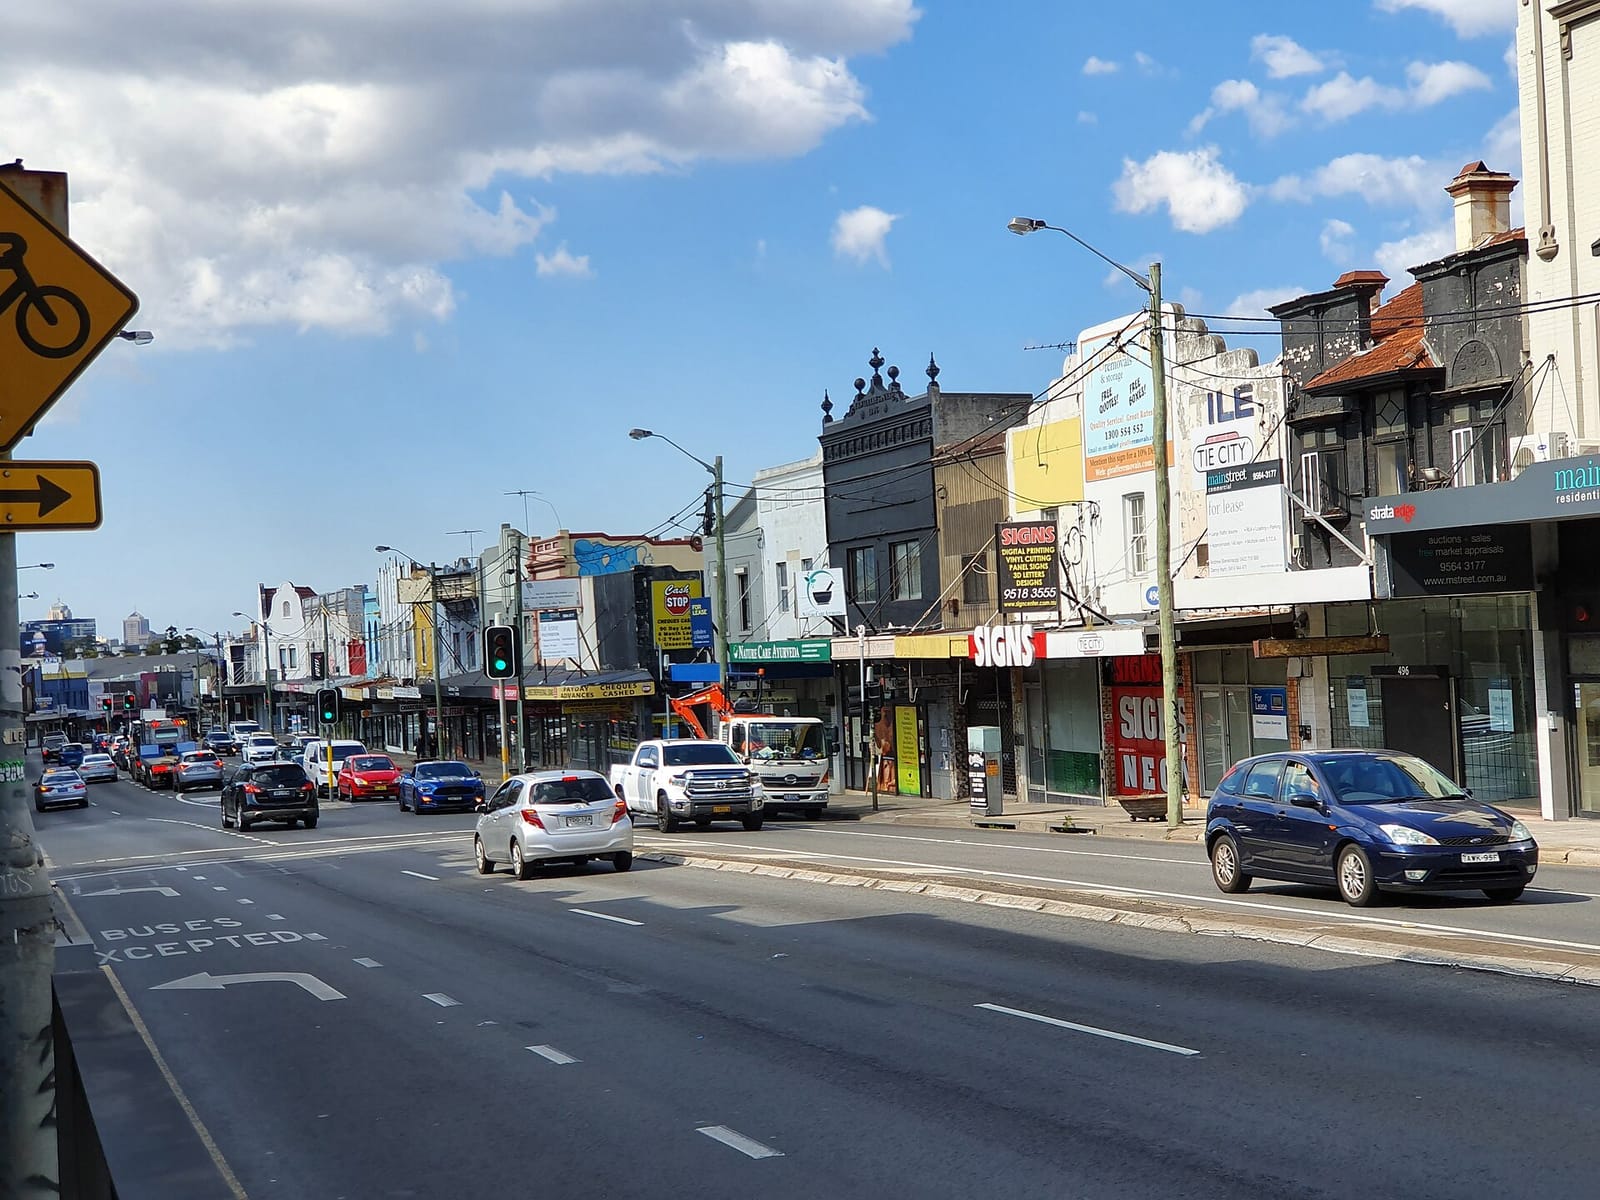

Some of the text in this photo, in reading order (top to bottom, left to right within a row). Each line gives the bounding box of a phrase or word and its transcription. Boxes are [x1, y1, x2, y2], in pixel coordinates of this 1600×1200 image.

[1130, 377, 1141, 394] FREE
[1101, 387, 1112, 402] FREE
[1129, 384, 1146, 406] BOXES!
[1099, 394, 1119, 414] QUOTES!
[1105, 429, 1119, 440] 1300
[1197, 441, 1246, 468] TIE CITY
[1209, 498, 1244, 516] for lease
[1001, 525, 1056, 546] SIGNS
[1428, 534, 1462, 546] auctions
[1471, 532, 1492, 544] sales
[1001, 546, 1056, 556] DIGITAL PRINTING
[1435, 547, 1463, 557] market
[1464, 544, 1504, 558] appraisals
[1006, 555, 1052, 564] VINYL CUTTING
[1439, 560, 1486, 572] 9564 3177
[1022, 570, 1046, 579] LETTERS
[1423, 574, 1507, 587] www.mstreet.com.au
[1016, 579, 1043, 587] DESIGNS
[665, 584, 690, 596] Cash
[1003, 587, 1057, 600] 9518 3555
[667, 597, 689, 608] STOP
[757, 643, 772, 659] CARE
[973, 624, 1035, 668] SIGNS
[1397, 665, 1410, 676] 496
[600, 683, 638, 691] CHEQUES
[602, 689, 635, 698] CASHED
[101, 917, 243, 941] BUSES
